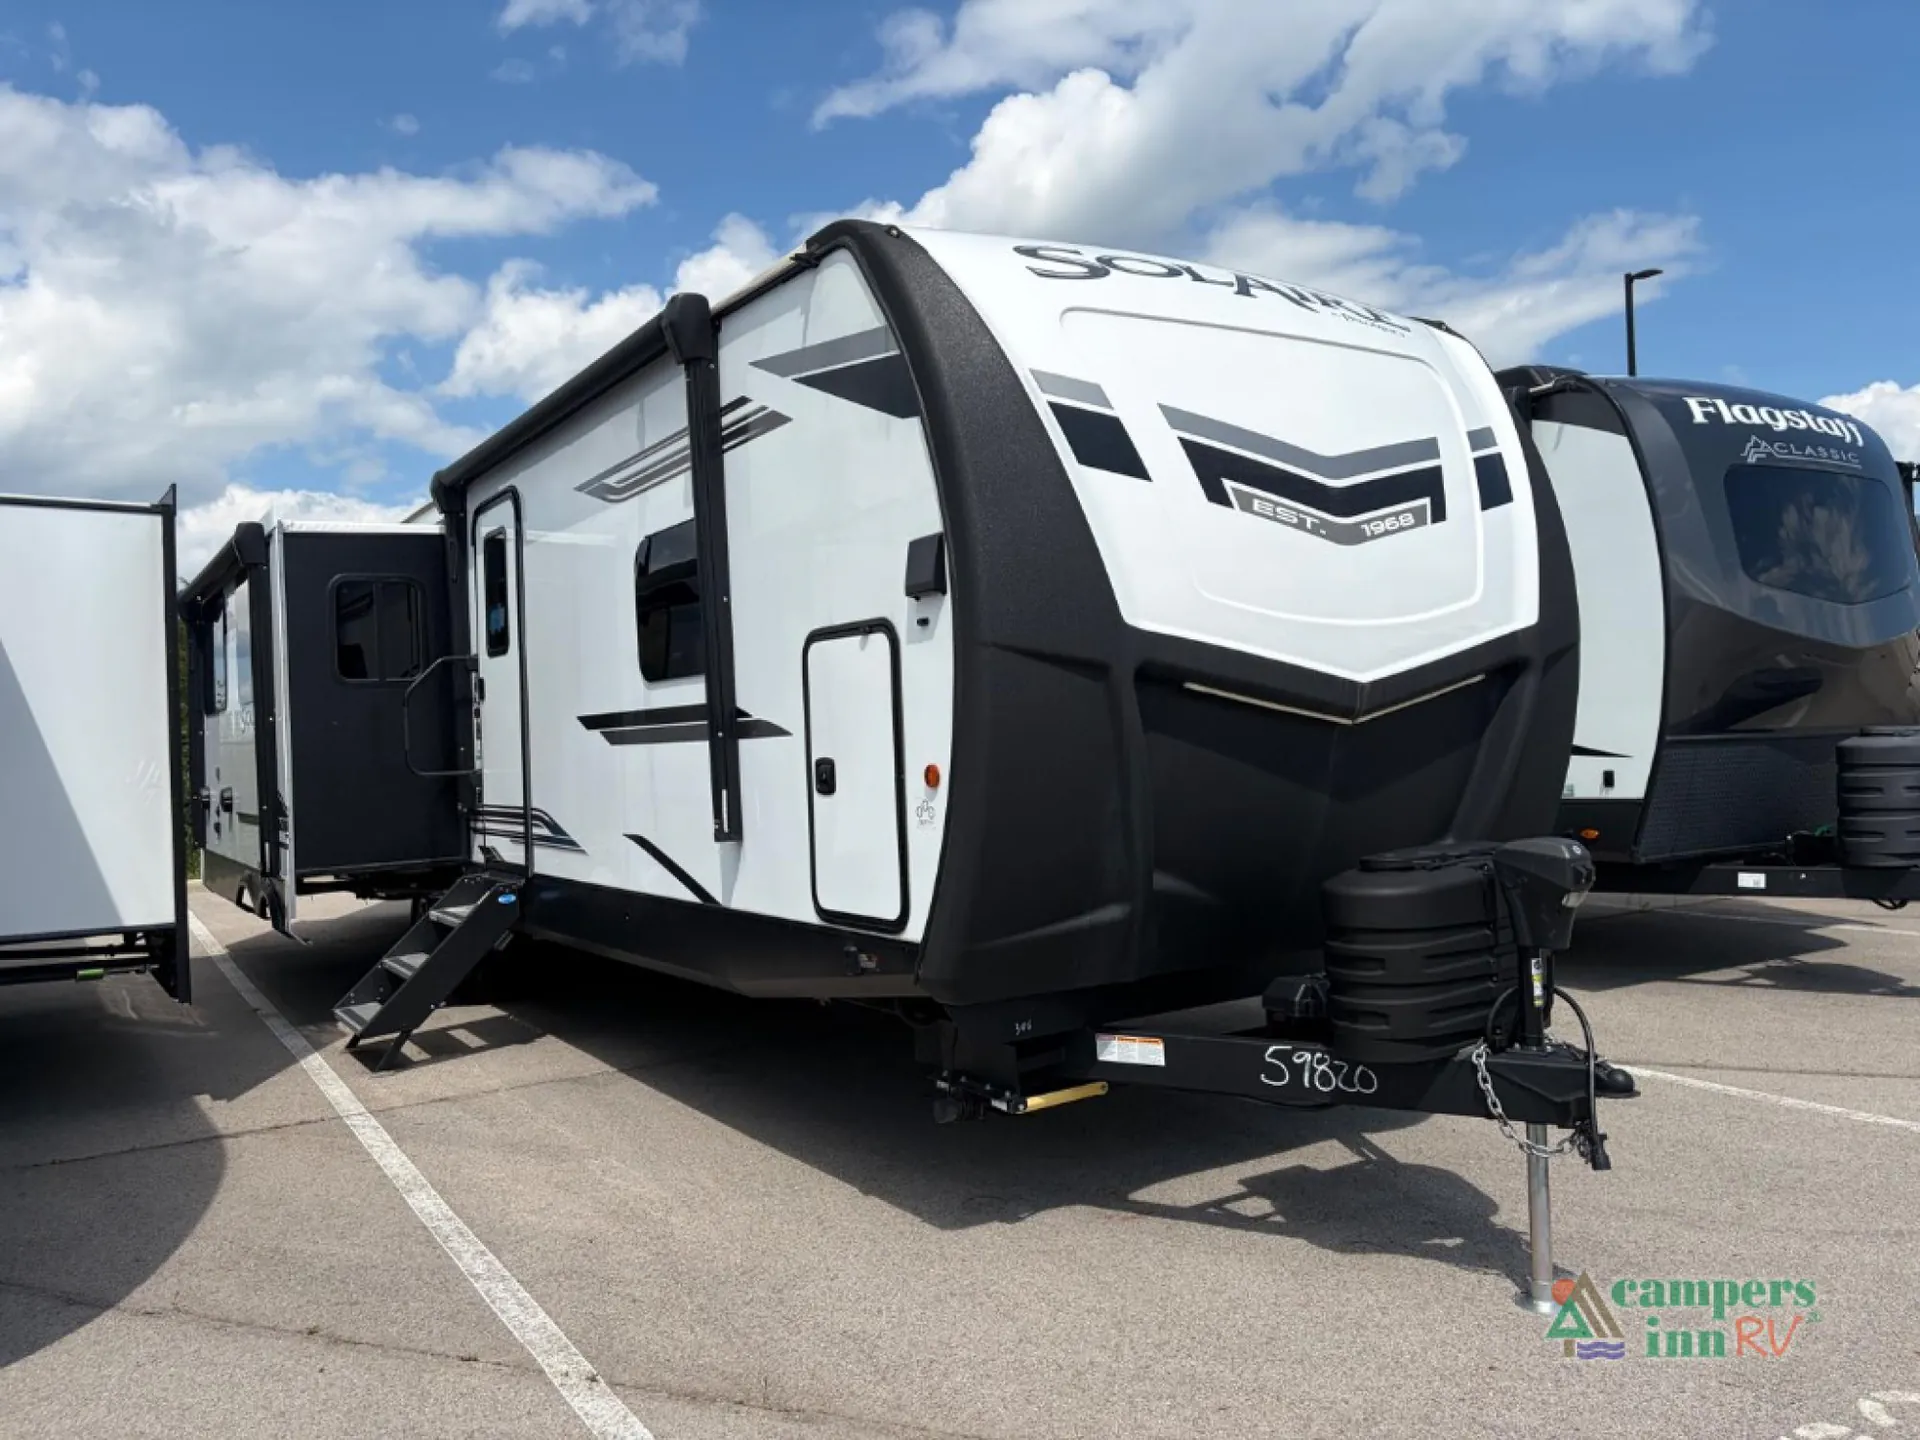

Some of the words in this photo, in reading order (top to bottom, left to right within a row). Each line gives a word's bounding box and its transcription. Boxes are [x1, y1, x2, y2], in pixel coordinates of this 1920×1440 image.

[1682, 396, 1864, 447] Flagstaff
[1773, 441, 1860, 464] CLASSIC
[1252, 498, 1327, 535] EST.
[1360, 512, 1415, 537] 1968
[1260, 1045, 1377, 1093] 59820
